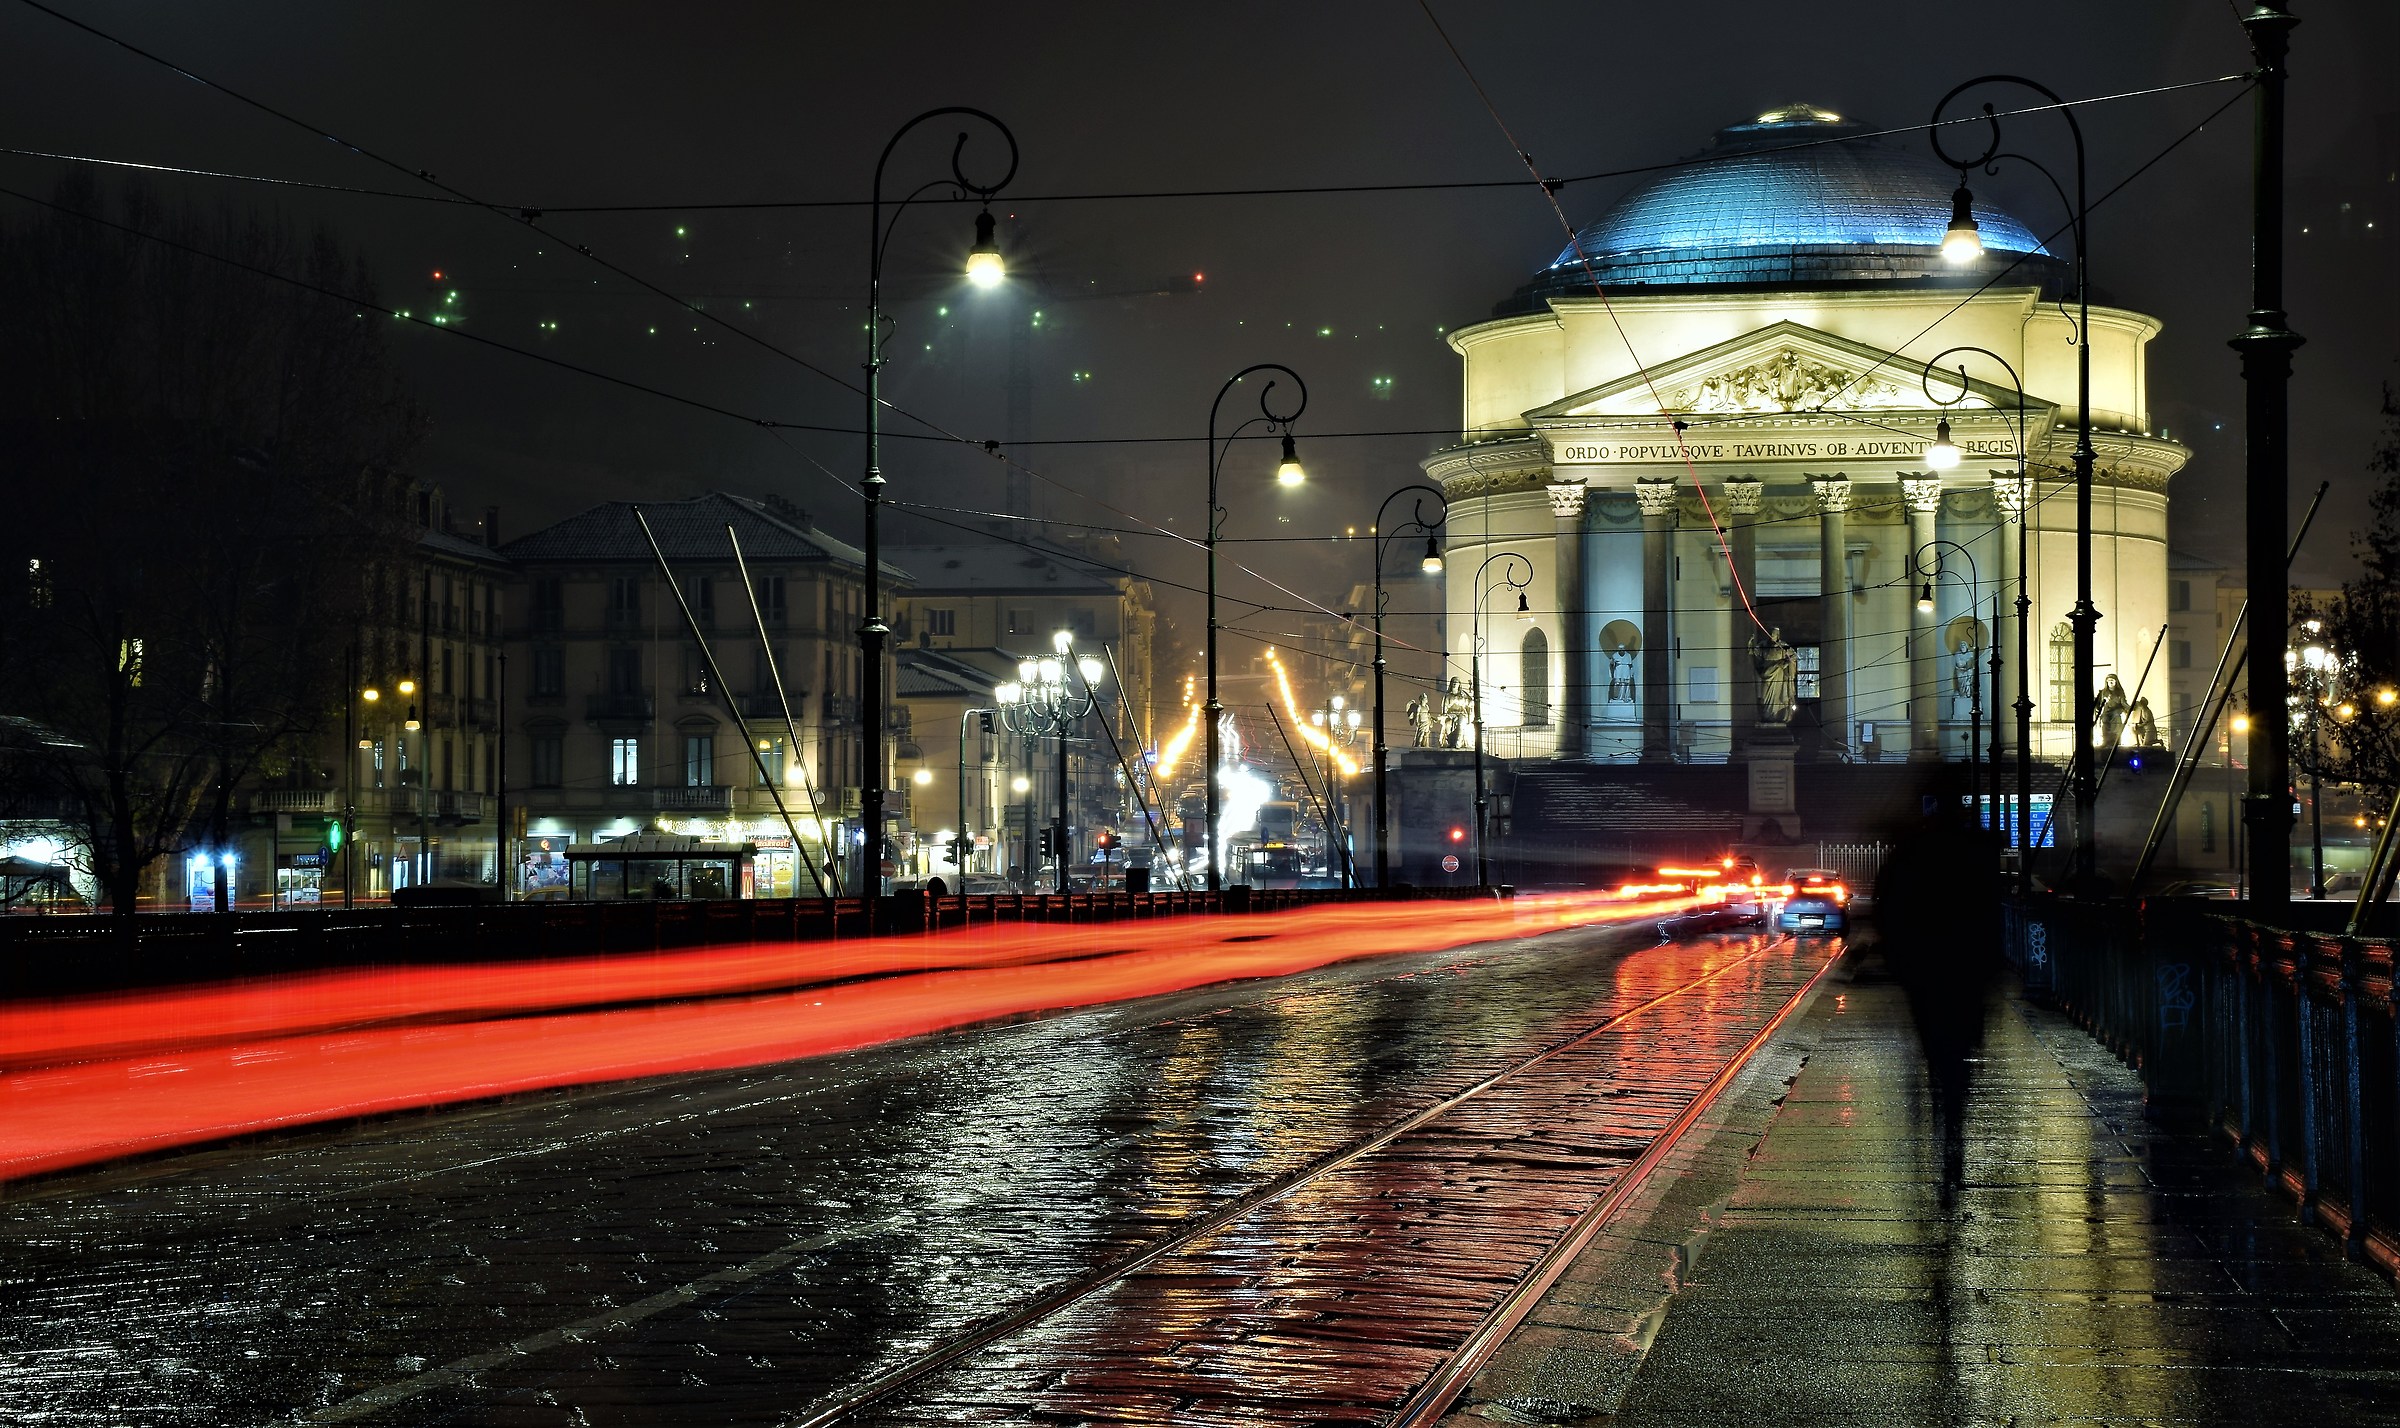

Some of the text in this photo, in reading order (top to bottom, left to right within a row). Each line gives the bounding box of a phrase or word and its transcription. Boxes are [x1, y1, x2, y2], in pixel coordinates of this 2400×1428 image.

[1565, 446, 1610, 460] ORDO
[1619, 445, 1724, 460] POPVLVSQVE
[1732, 443, 1818, 458] TAVRINVS
[1827, 442, 1848, 456] OB
[1966, 439, 2014, 454] REGIS
